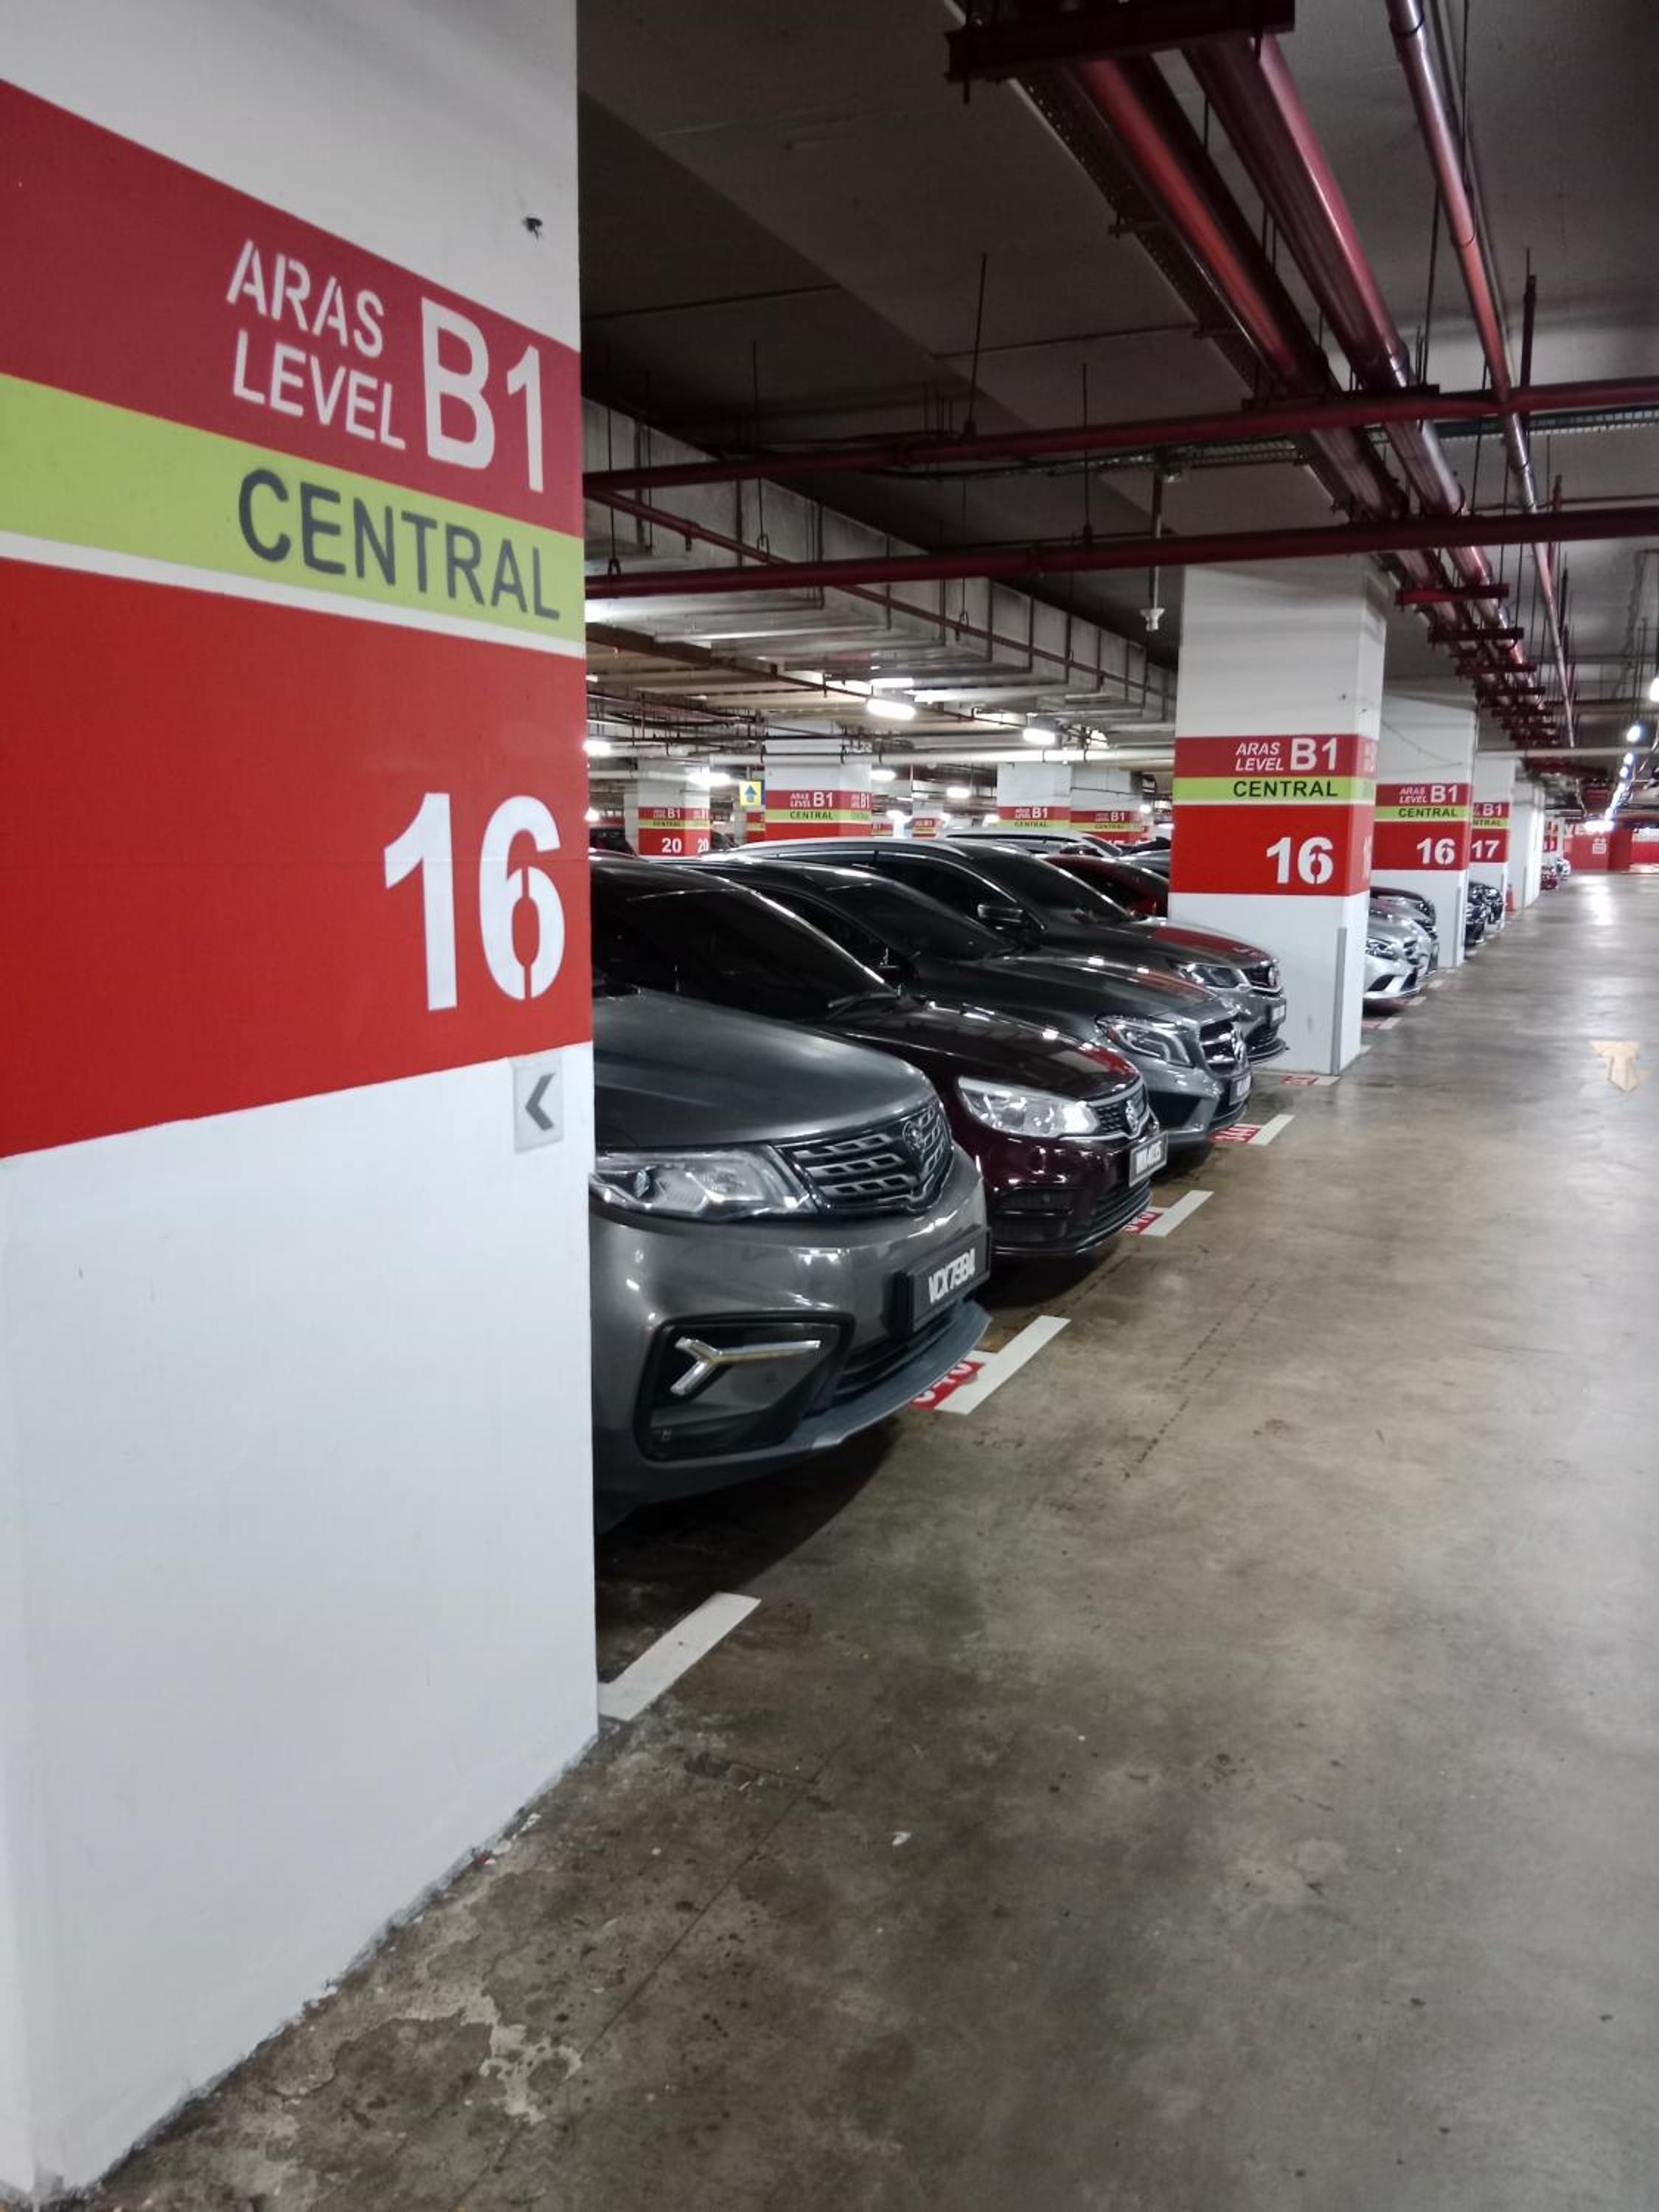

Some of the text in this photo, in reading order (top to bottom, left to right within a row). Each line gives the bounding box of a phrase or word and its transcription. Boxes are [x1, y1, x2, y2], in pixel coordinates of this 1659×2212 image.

[226, 240, 386, 358] ARAS
[232, 329, 406, 450] LEVEL
[421, 296, 545, 494] B1
[237, 468, 561, 621] CENTRAL
[1235, 742, 1281, 756] ARAS
[1290, 737, 1338, 771] B1
[1235, 758, 1284, 771] LEVEL
[1233, 780, 1339, 797] CENTRAL
[1399, 787, 1426, 795] ARAS
[1430, 785, 1458, 803] B1
[813, 792, 833, 807] B1
[1399, 796, 1427, 804] LEVEL
[667, 807, 681, 818] B1
[790, 812, 834, 820] CENTRAL
[1032, 807, 1048, 818] B1
[1110, 812, 1125, 821] B1
[1398, 807, 1458, 818] CENTRAL
[1483, 803, 1503, 816] B1
[661, 837, 682, 854] 20
[1416, 838, 1455, 865] 16
[1471, 840, 1500, 859] 17
[1266, 836, 1334, 885] 16
[383, 792, 566, 1012] 16
